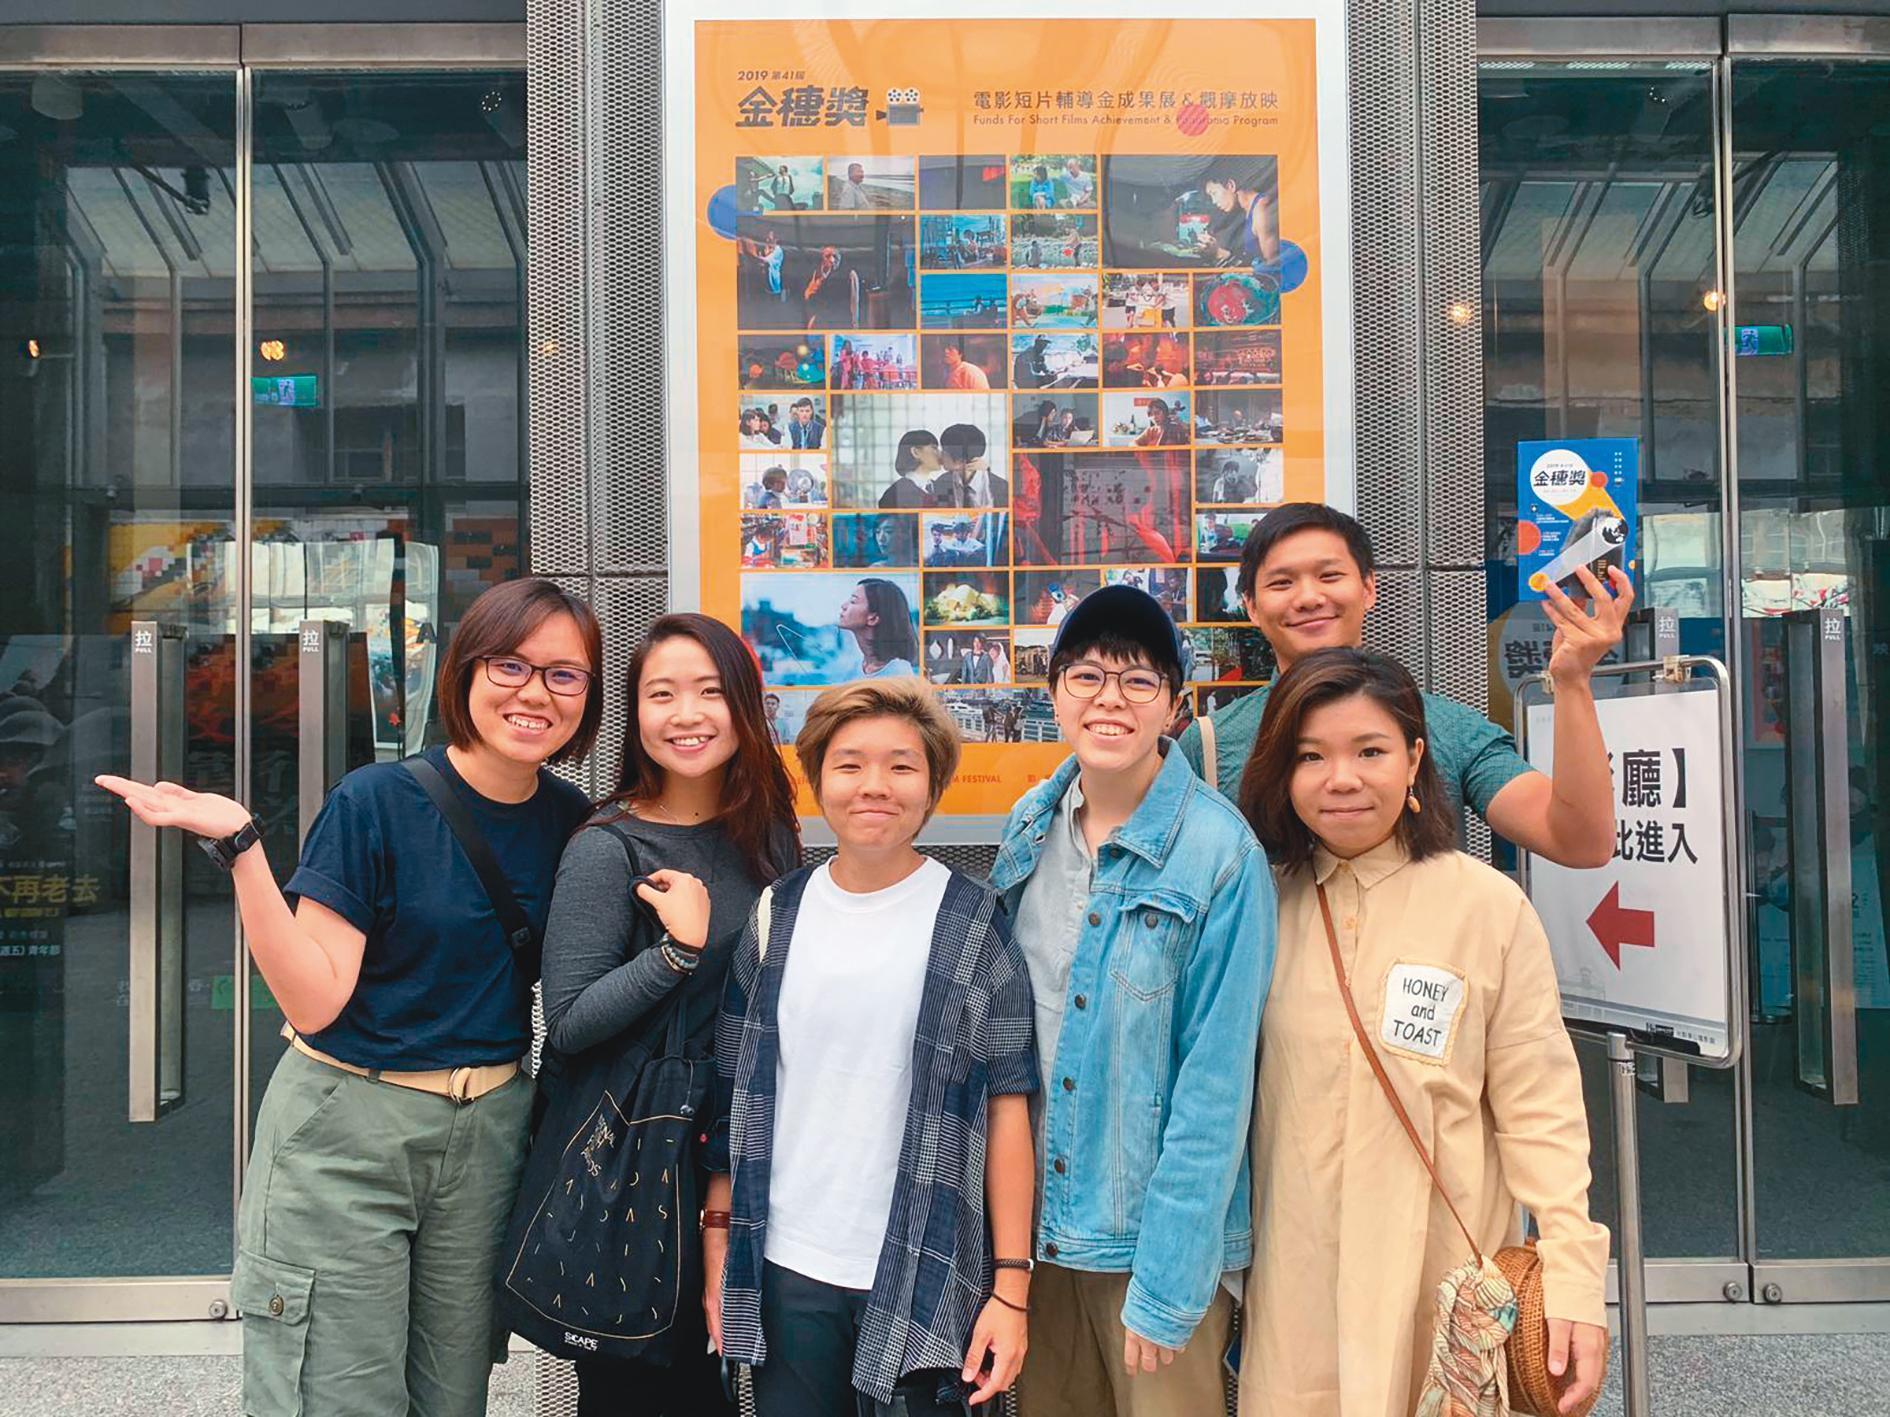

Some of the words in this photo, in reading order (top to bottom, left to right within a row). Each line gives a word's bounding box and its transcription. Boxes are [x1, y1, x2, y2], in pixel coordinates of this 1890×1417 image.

[737, 70, 769, 81] 2019
[735, 85, 869, 128] 金穗獎
[973, 114, 1004, 125] Funds
[1008, 114, 1025, 125] For
[1030, 114, 1058, 125] Short
[1062, 114, 1088, 125] Films
[1092, 114, 1160, 125] Achievement
[1233, 114, 1279, 128] Program
[1533, 470, 1586, 487] 金穗獎
[1659, 616, 1676, 632] 拉
[1824, 618, 1841, 634] 拉
[135, 630, 152, 647] 拉
[302, 629, 319, 646] 拉
[962, 774, 1001, 783] FESTIVAL
[1608, 748, 1686, 808] 廳】
[1402, 977, 1449, 1002] HONEY
[1410, 1004, 1436, 1021] and
[1393, 1019, 1442, 1047] TOAST
